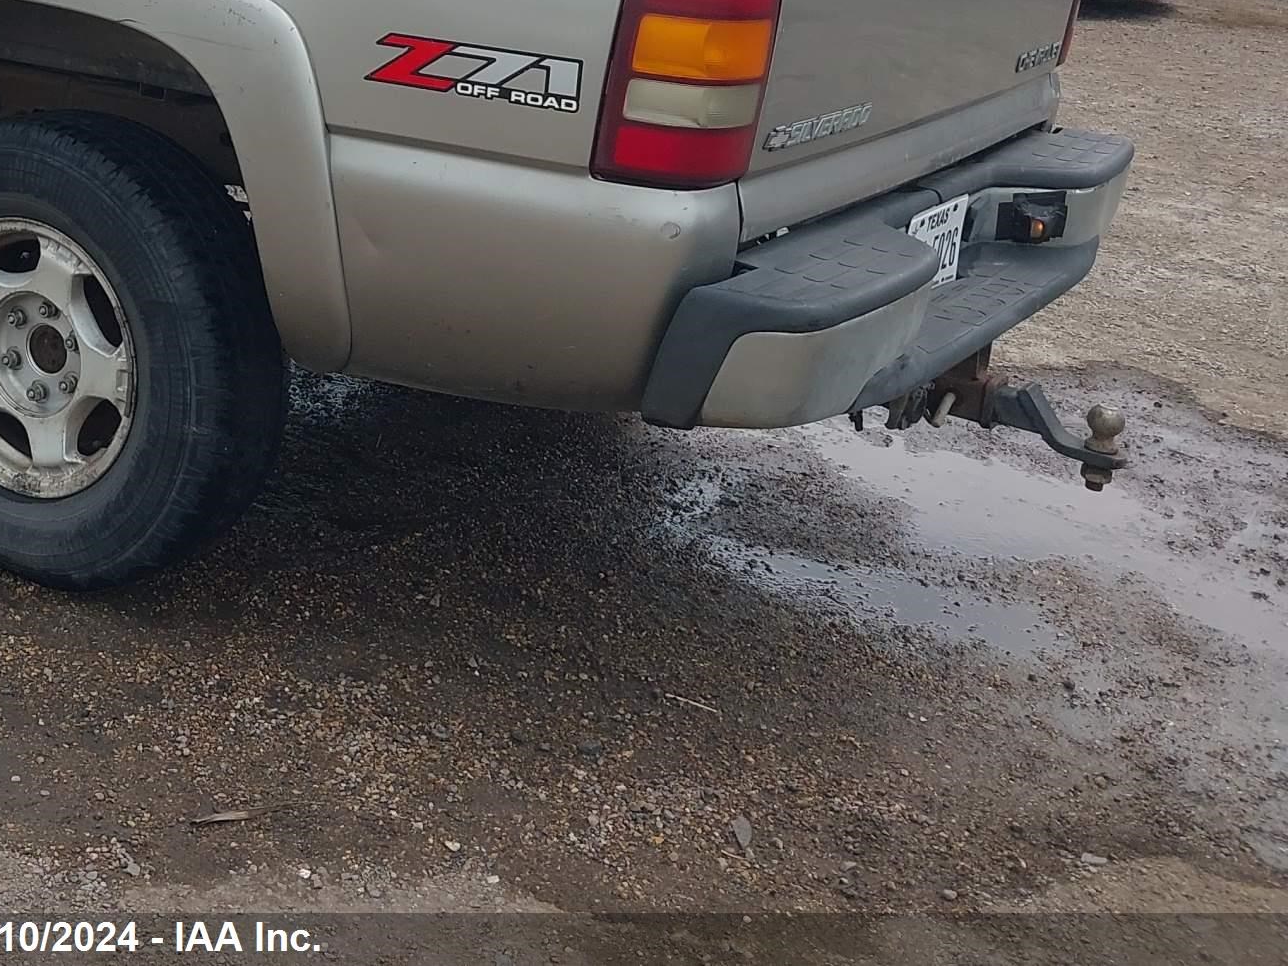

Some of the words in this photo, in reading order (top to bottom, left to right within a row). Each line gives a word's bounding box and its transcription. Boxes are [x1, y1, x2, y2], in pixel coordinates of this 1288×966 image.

[364, 33, 584, 100] Z71
[455, 82, 500, 99] OFF
[510, 90, 578, 112] ROAD
[786, 103, 873, 147] SILVERADO
[926, 207, 951, 233] TEXAS
